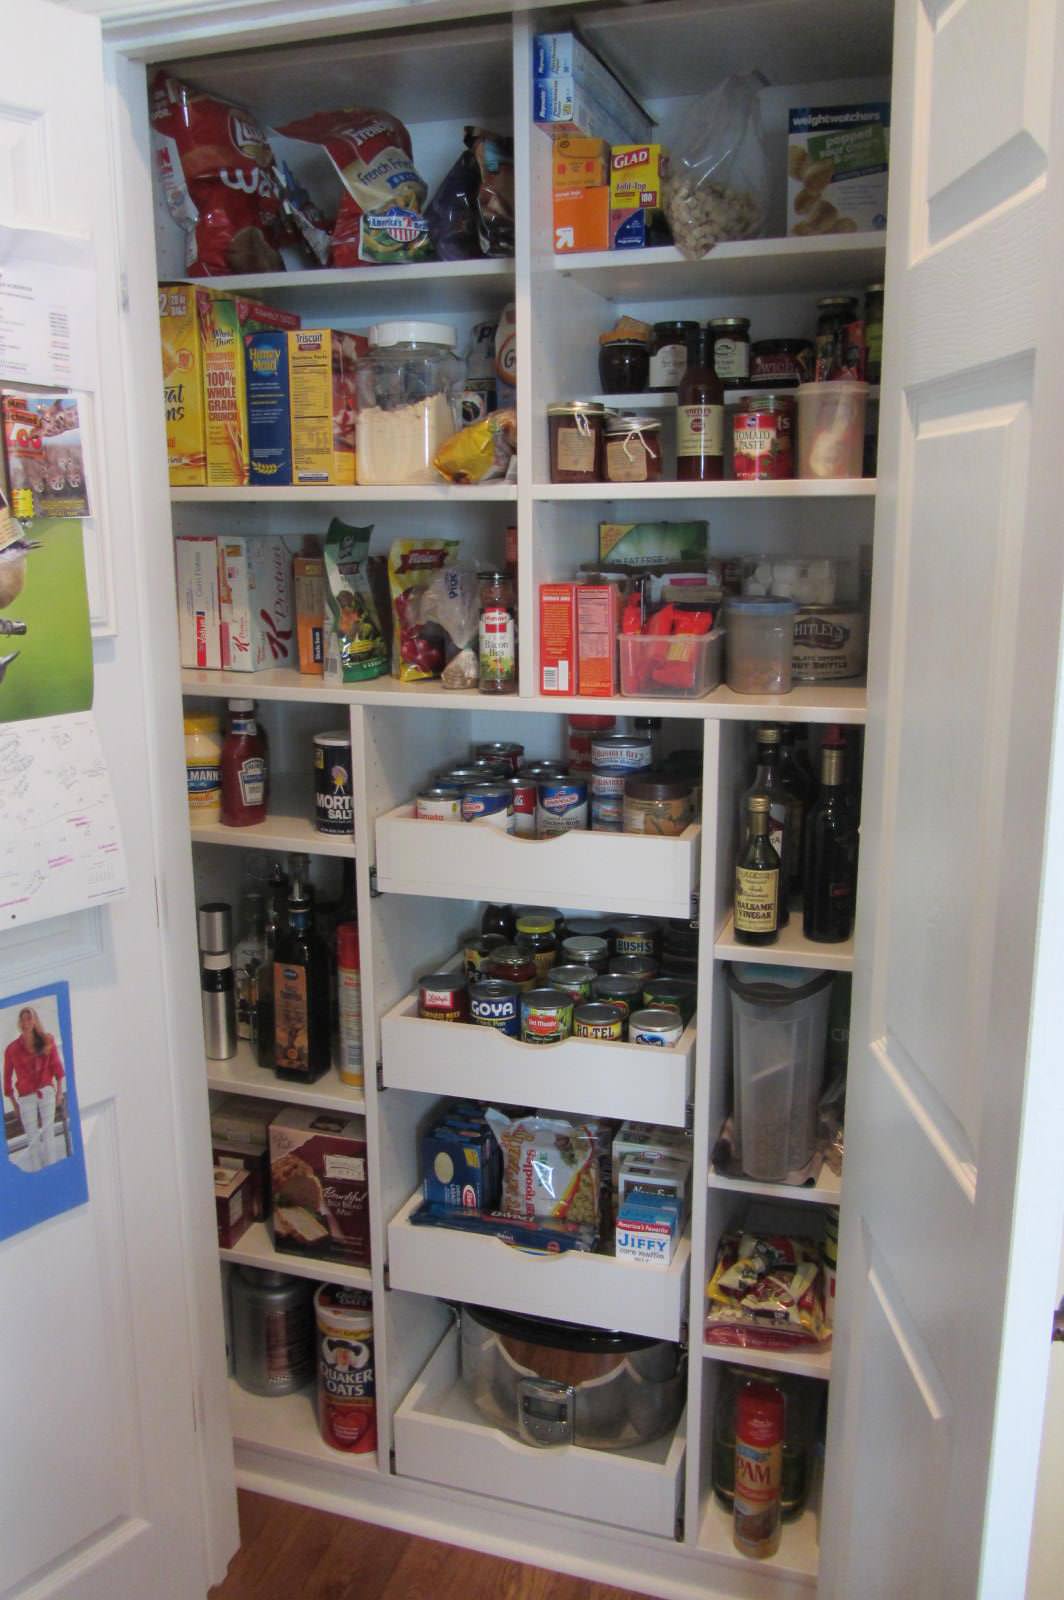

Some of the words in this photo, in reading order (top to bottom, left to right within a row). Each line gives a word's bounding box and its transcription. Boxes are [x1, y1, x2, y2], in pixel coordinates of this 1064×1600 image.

[614, 151, 648, 169] GLAD
[295, 334, 322, 344] Triscuit
[249, 347, 280, 361] Honey
[206, 372, 236, 387] 100%
[208, 387, 236, 399] WHOLE
[208, 400, 237, 412] GRAIN
[736, 430, 770, 441] TOMATO
[742, 440, 766, 450] PASTE
[261, 608, 293, 660] K
[232, 636, 248, 652] K
[484, 640, 509, 649] Bacon
[316, 792, 353, 810] MORT
[328, 809, 353, 820] SALT
[738, 911, 772, 920] VINEGAR
[471, 999, 513, 1017] GOYA
[617, 1232, 667, 1252] JIFFY
[320, 1361, 373, 1382] QUAKER
[327, 1380, 366, 1397] OATS
[735, 1457, 770, 1484] PAM
